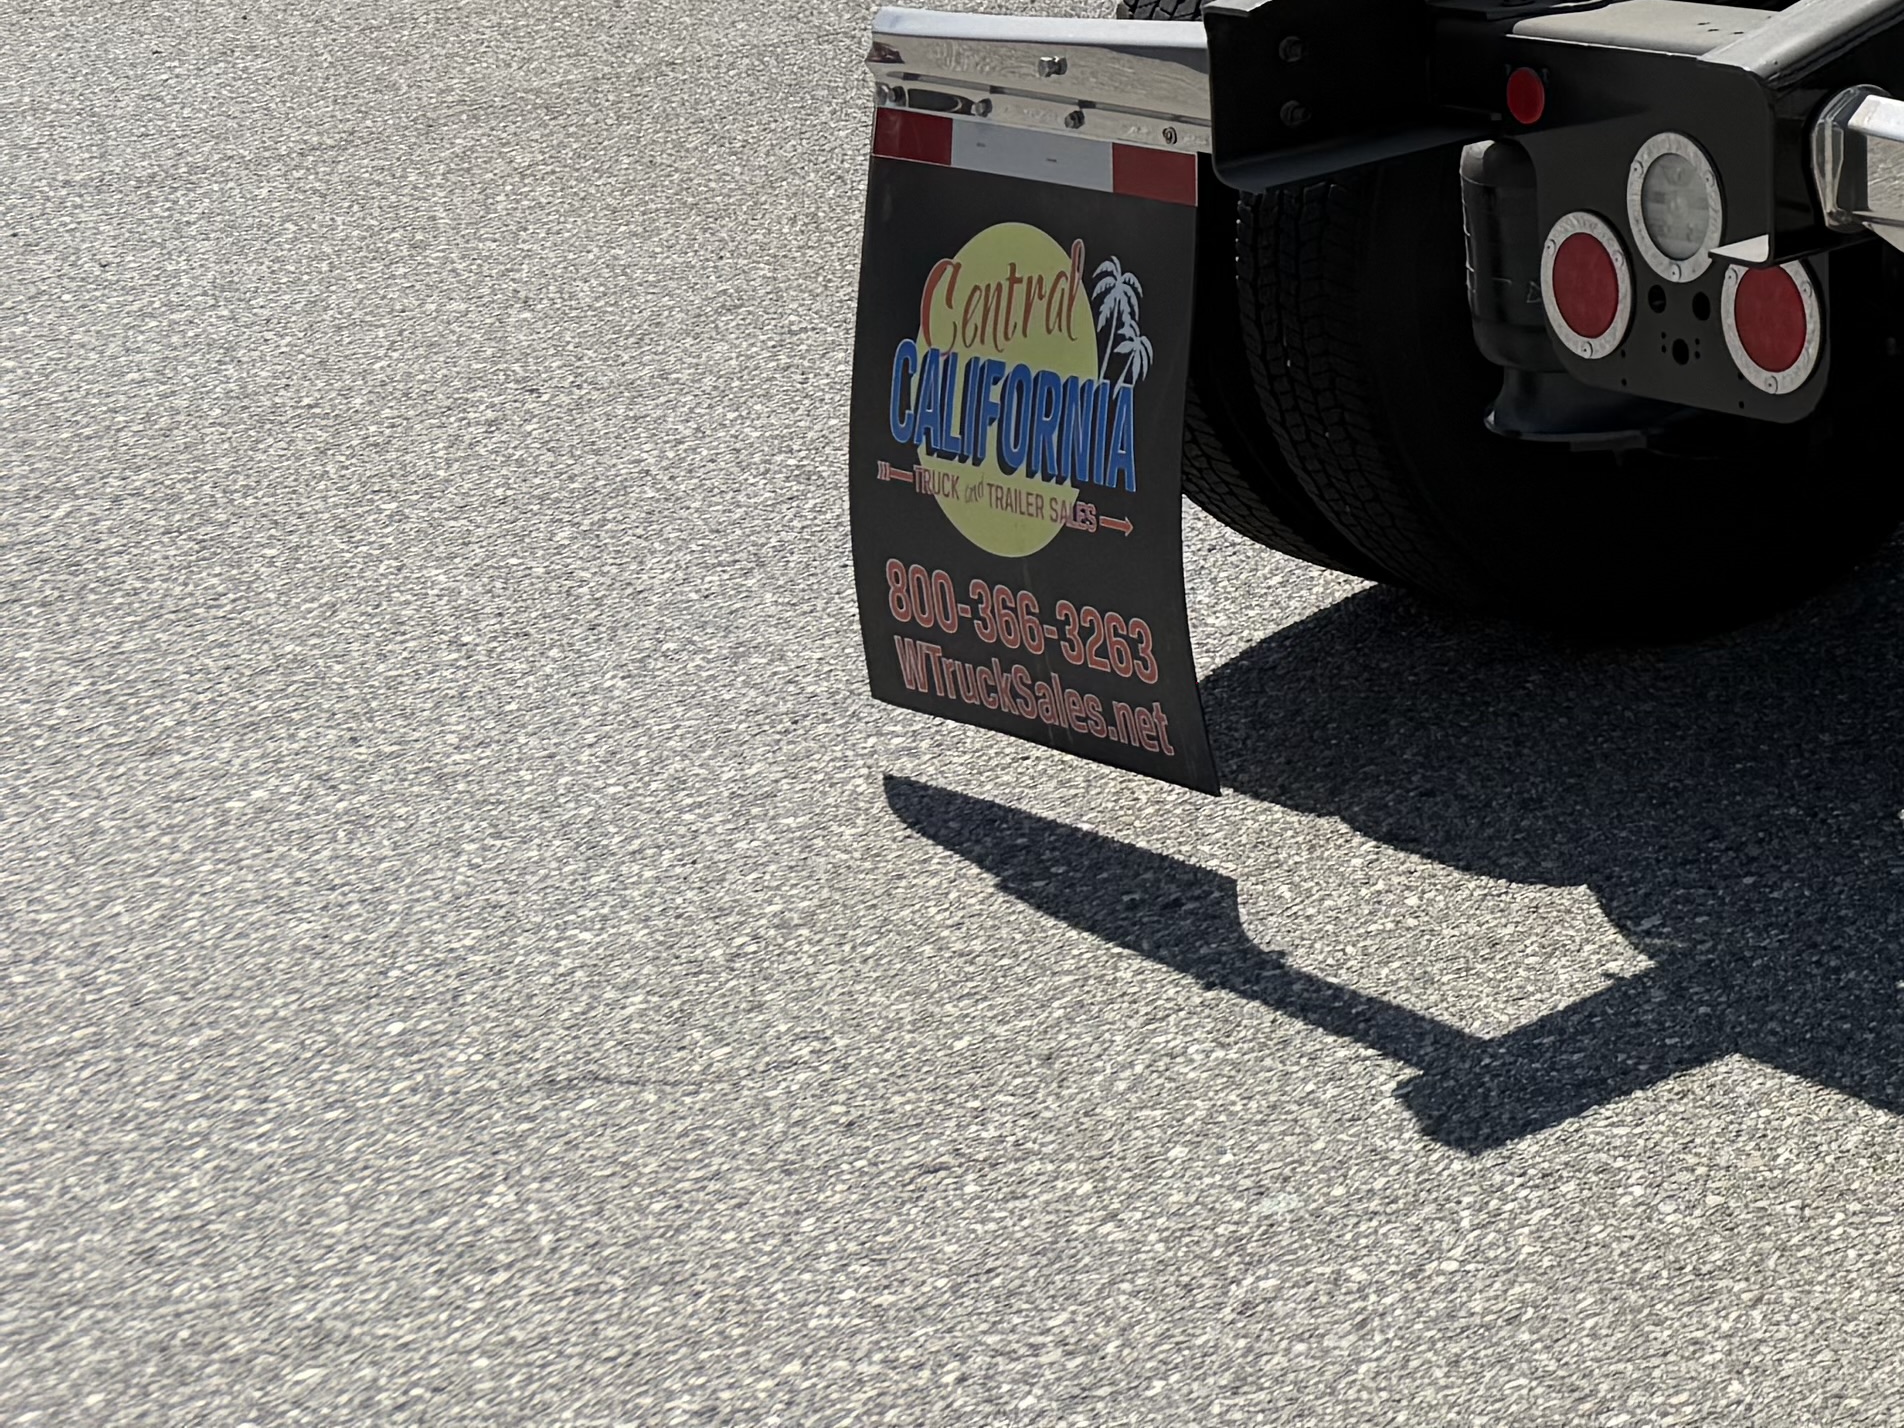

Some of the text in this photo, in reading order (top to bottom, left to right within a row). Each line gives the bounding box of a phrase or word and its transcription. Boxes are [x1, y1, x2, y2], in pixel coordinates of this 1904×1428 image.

[921, 239, 1085, 358] Central
[890, 338, 1137, 492] CALIFORNIA
[914, 464, 1098, 533] TRUCK and TRAILER SALES
[886, 558, 1158, 684] 800-366-3263
[894, 635, 1175, 756] WTruckSales.net
